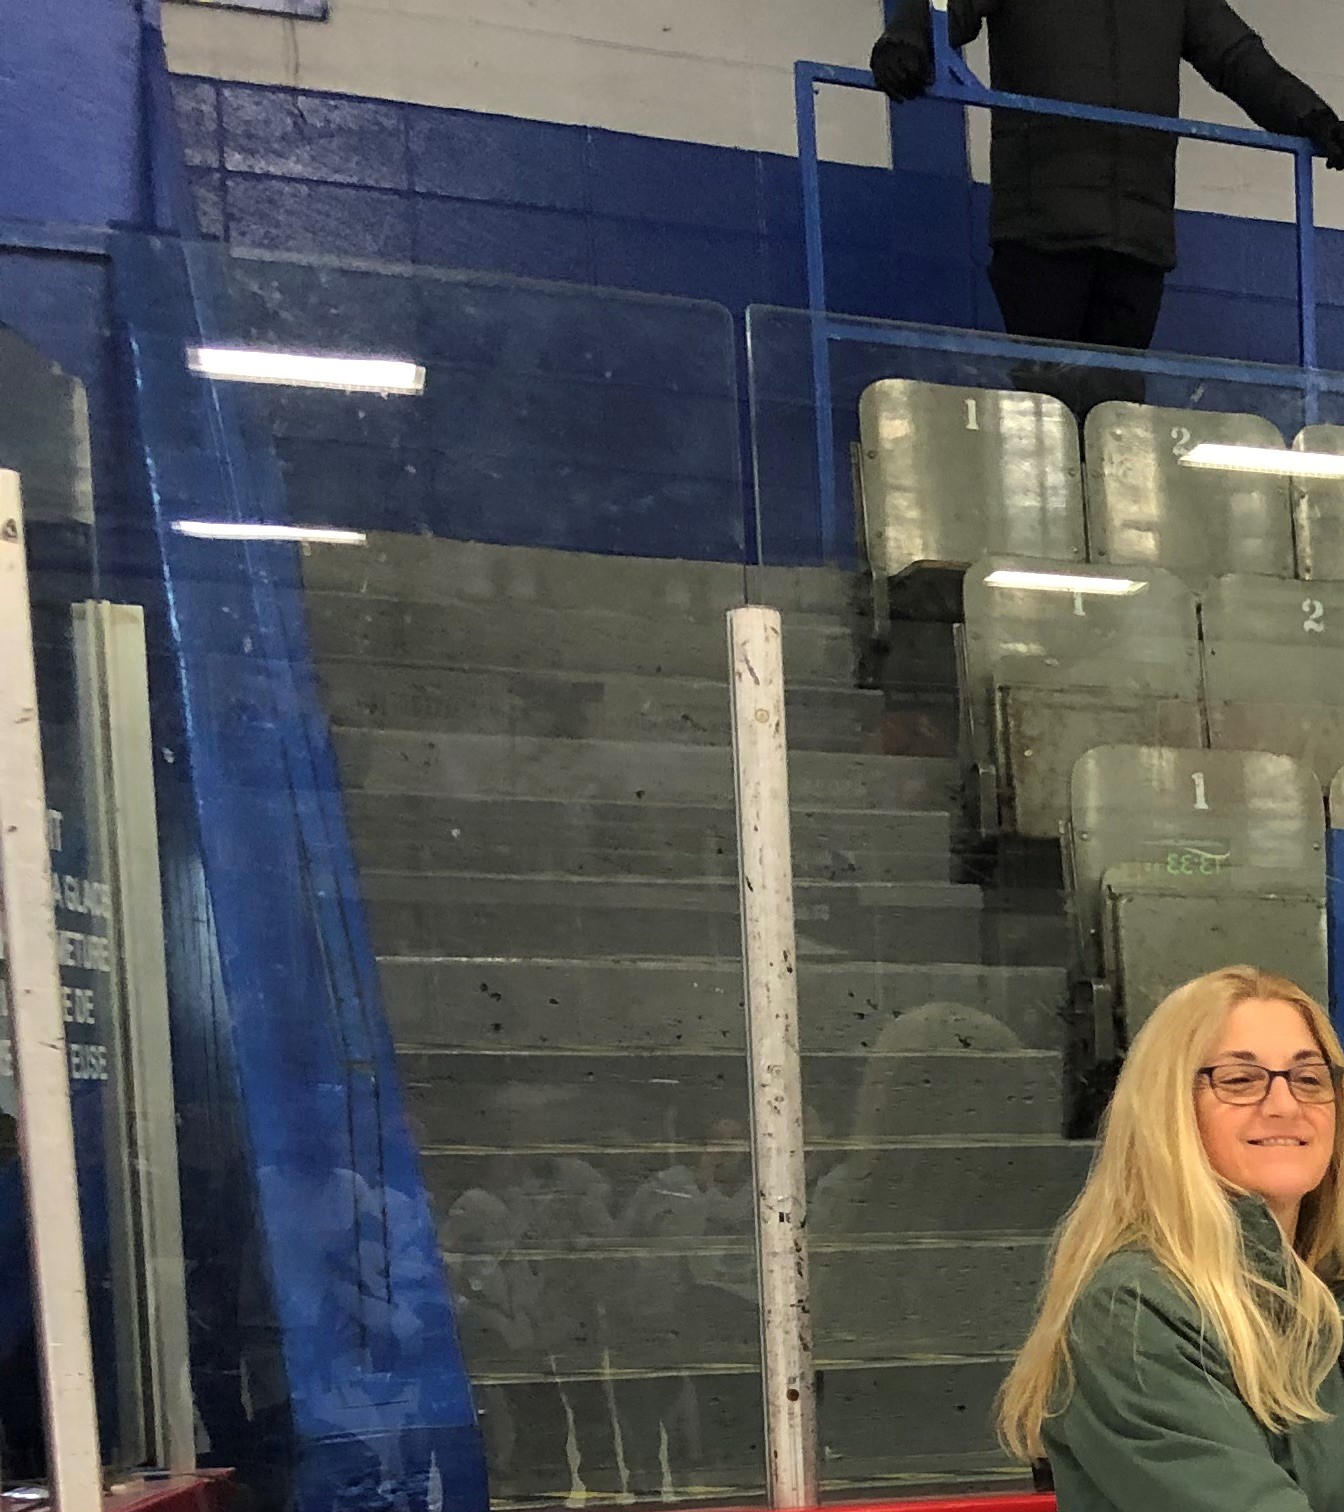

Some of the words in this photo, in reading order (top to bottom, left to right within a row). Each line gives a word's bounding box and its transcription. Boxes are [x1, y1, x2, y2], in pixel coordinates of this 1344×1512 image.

[965, 399, 979, 430] 1
[1171, 426, 1191, 456] 2
[1302, 598, 1324, 632] 2
[1191, 773, 1208, 810] 1
